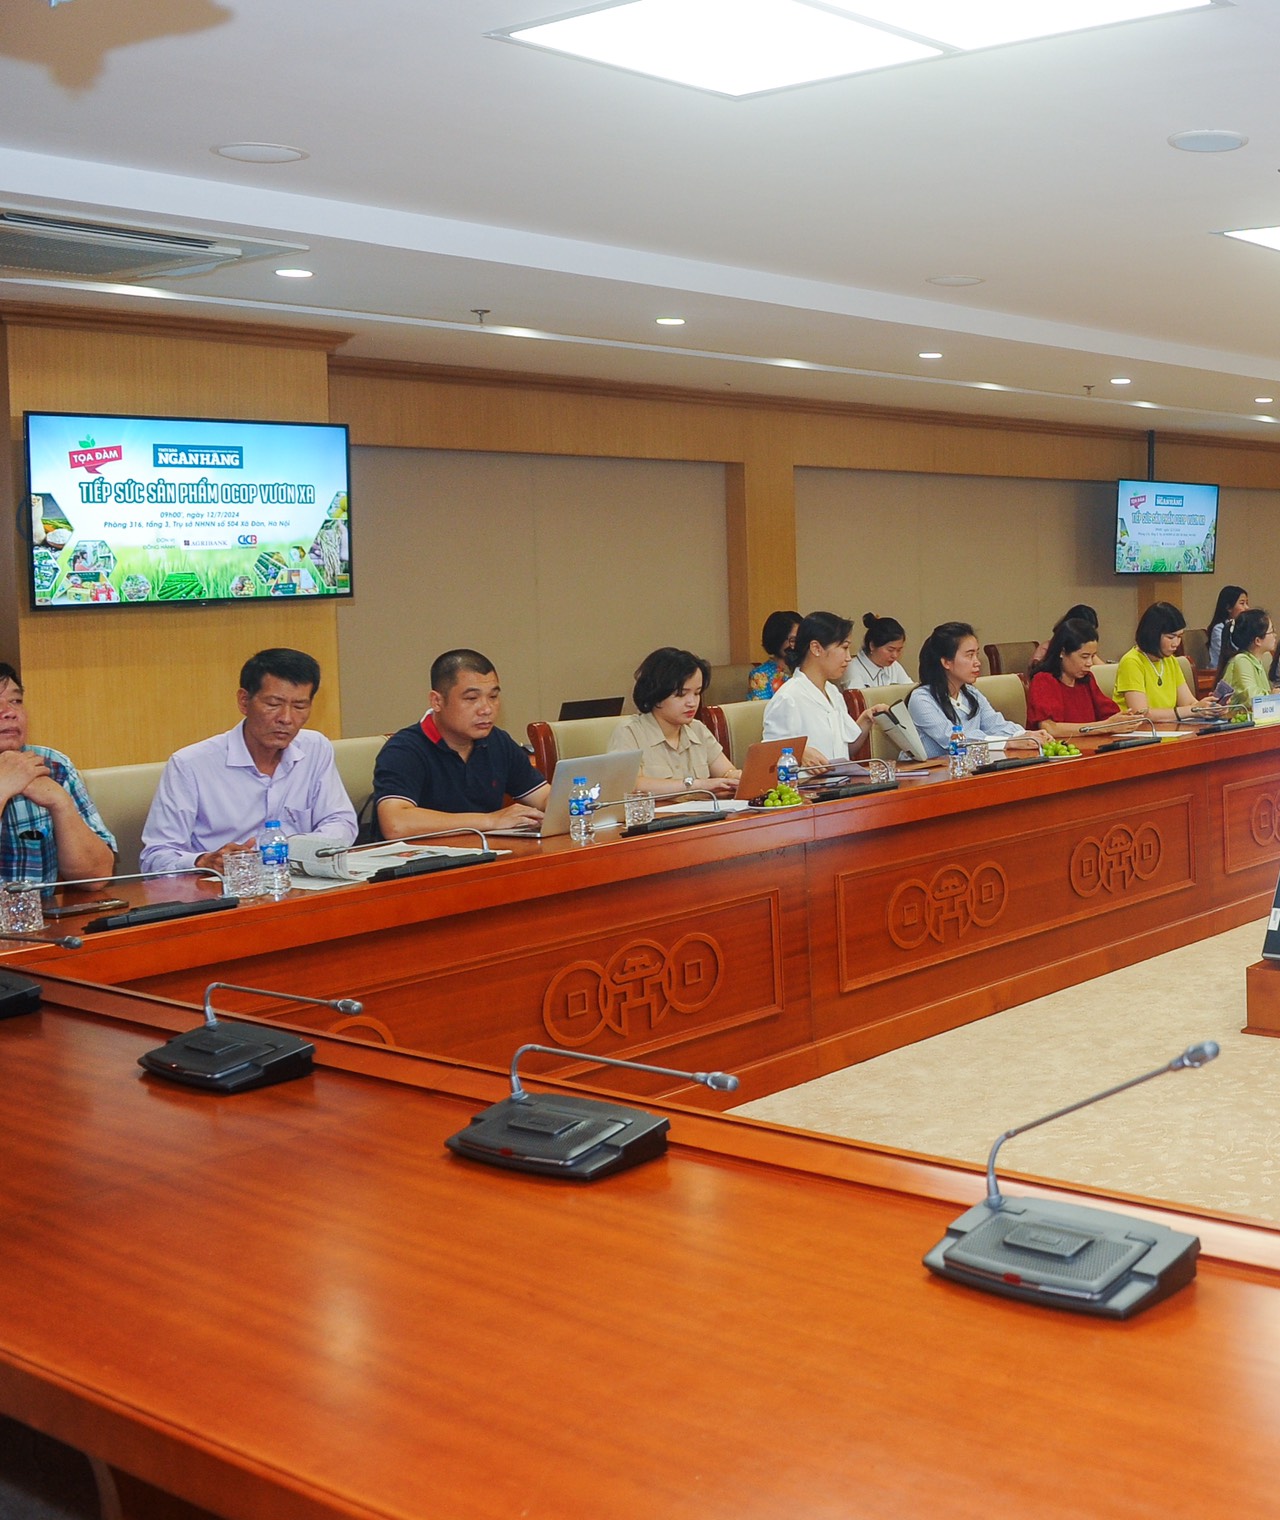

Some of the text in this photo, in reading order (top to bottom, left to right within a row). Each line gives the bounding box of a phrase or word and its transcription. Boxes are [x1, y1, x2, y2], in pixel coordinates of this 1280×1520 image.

[73, 450, 118, 464] TỌA ĐÀM
[79, 476, 315, 504] TIẾP SỨC SẢN PHẨM OCOP VƯƠN XA
